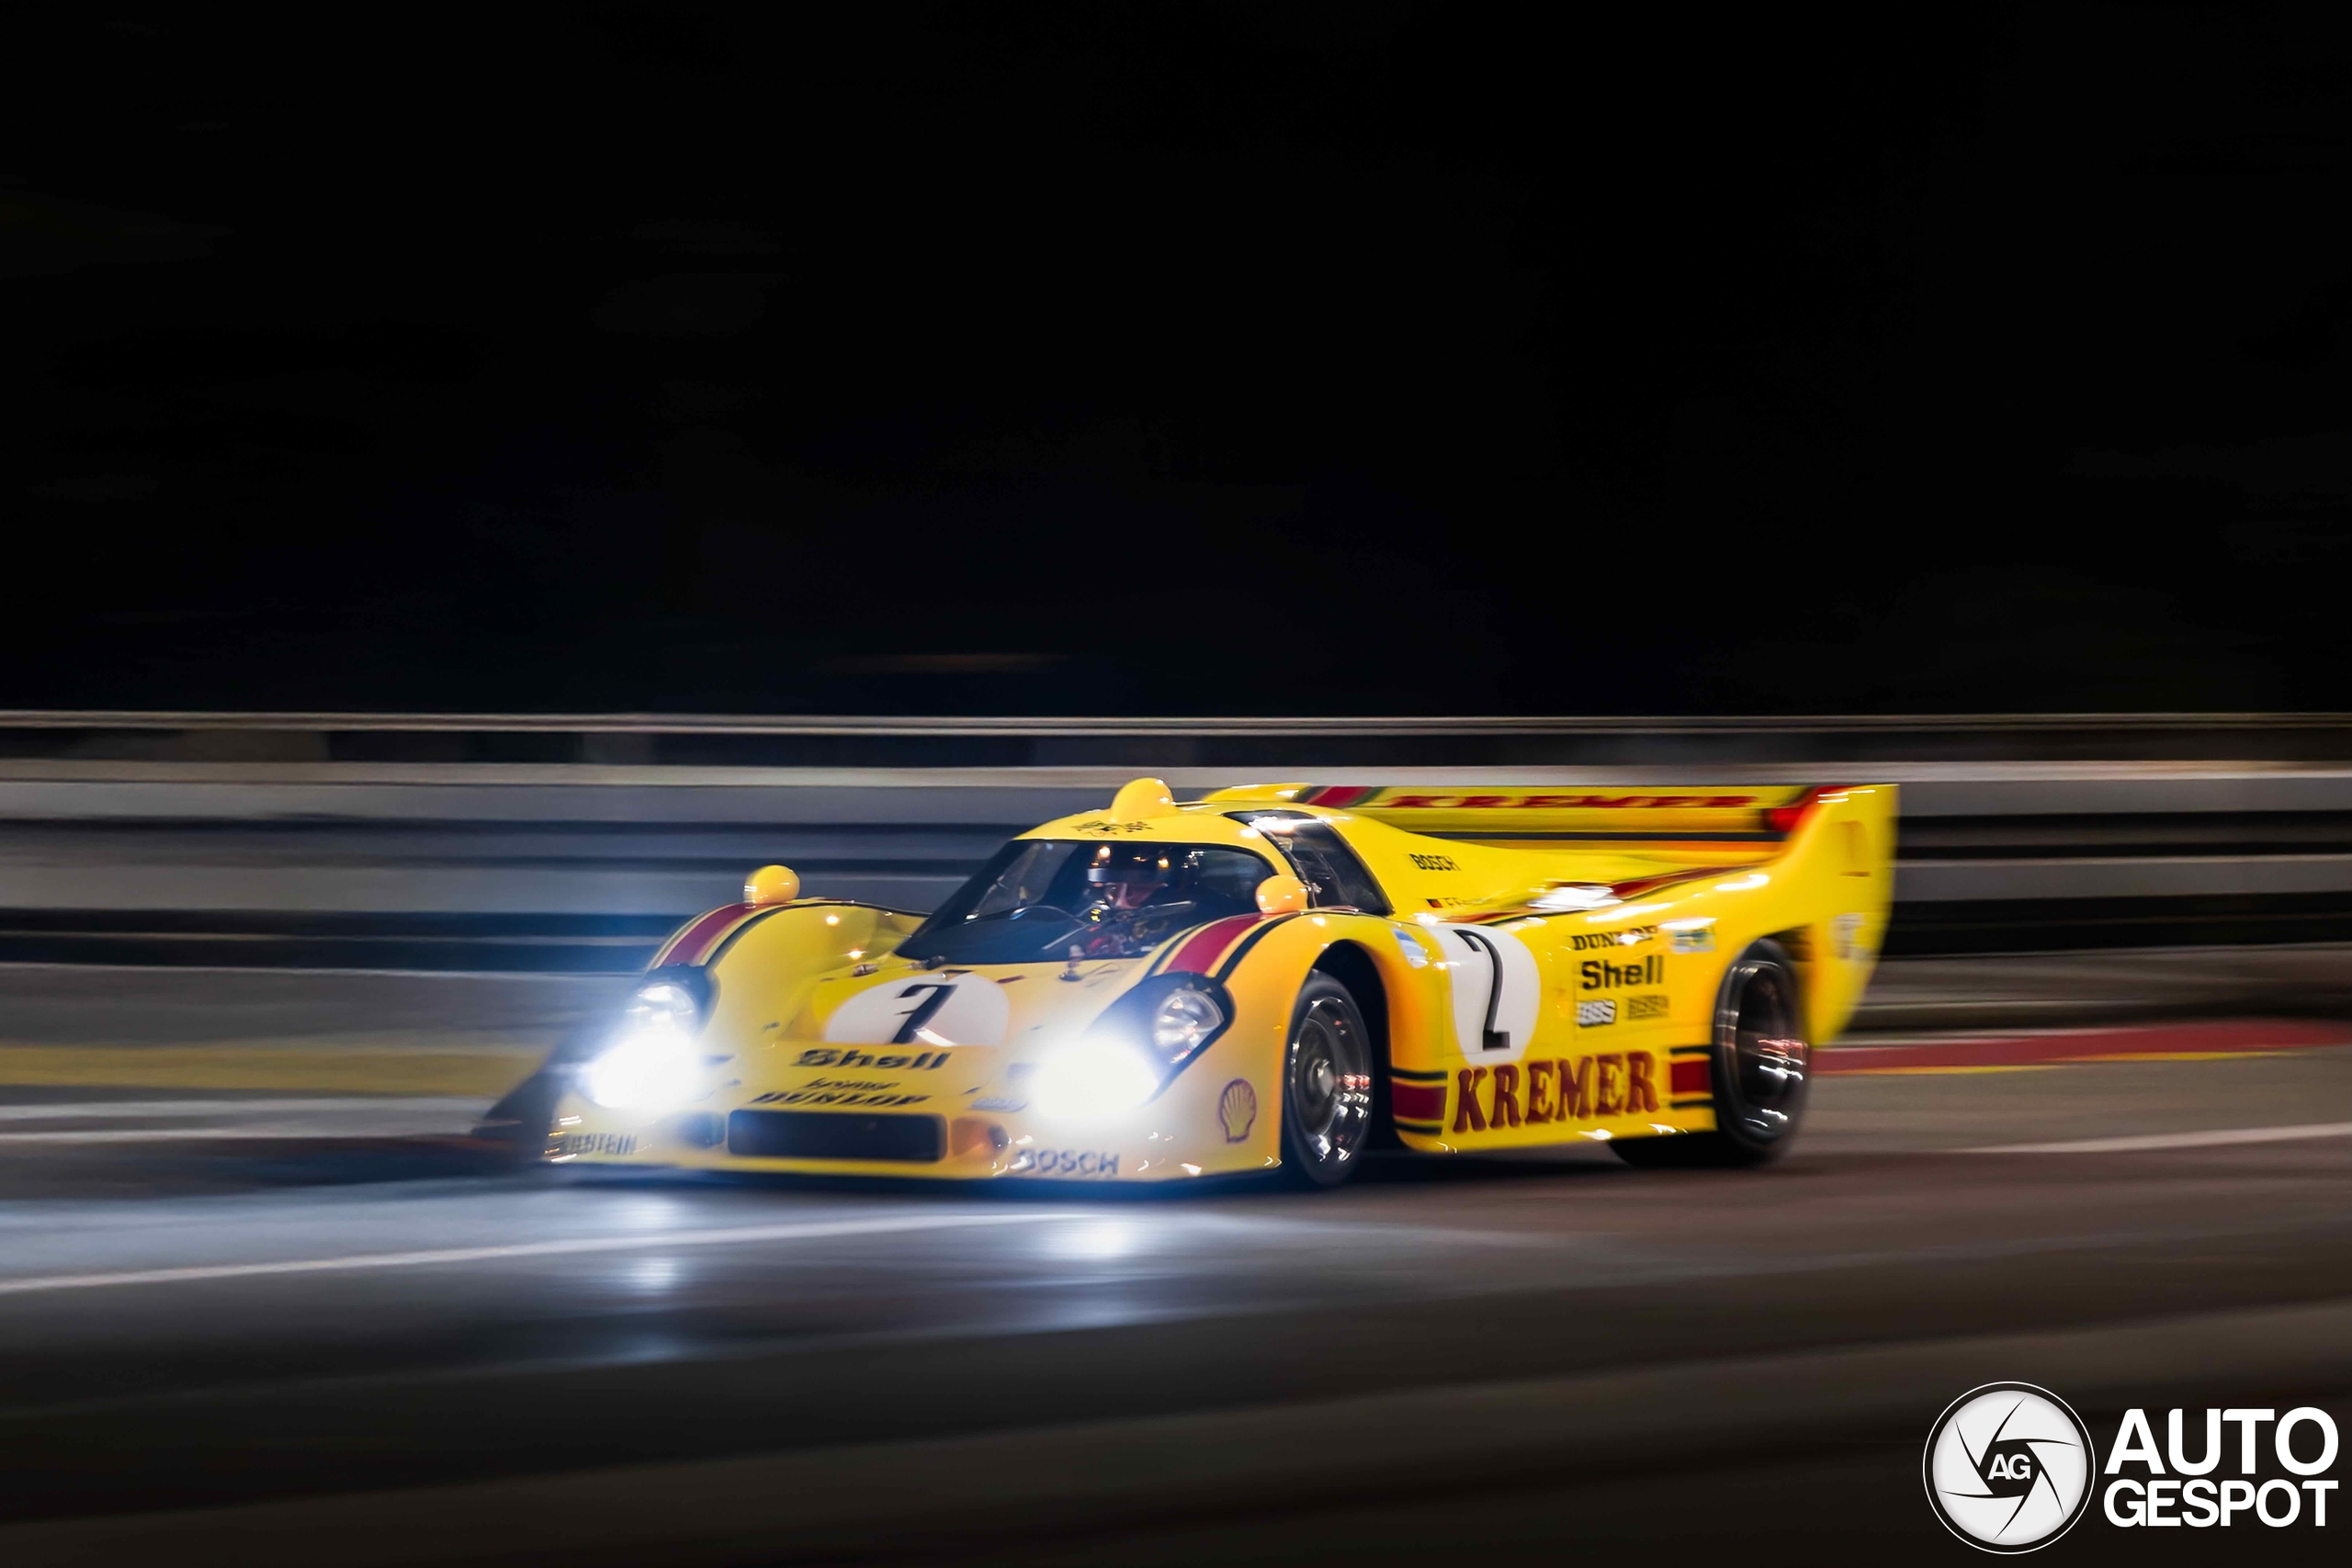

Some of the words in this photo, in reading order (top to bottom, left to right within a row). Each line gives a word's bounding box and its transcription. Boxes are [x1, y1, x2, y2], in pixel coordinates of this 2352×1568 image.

[1408, 853, 1462, 871] BOSCH
[1453, 928, 1511, 1051] 2
[1581, 953, 1664, 990] Shell
[791, 1048, 952, 1069] Shell
[1452, 1051, 1660, 1134] KREMER
